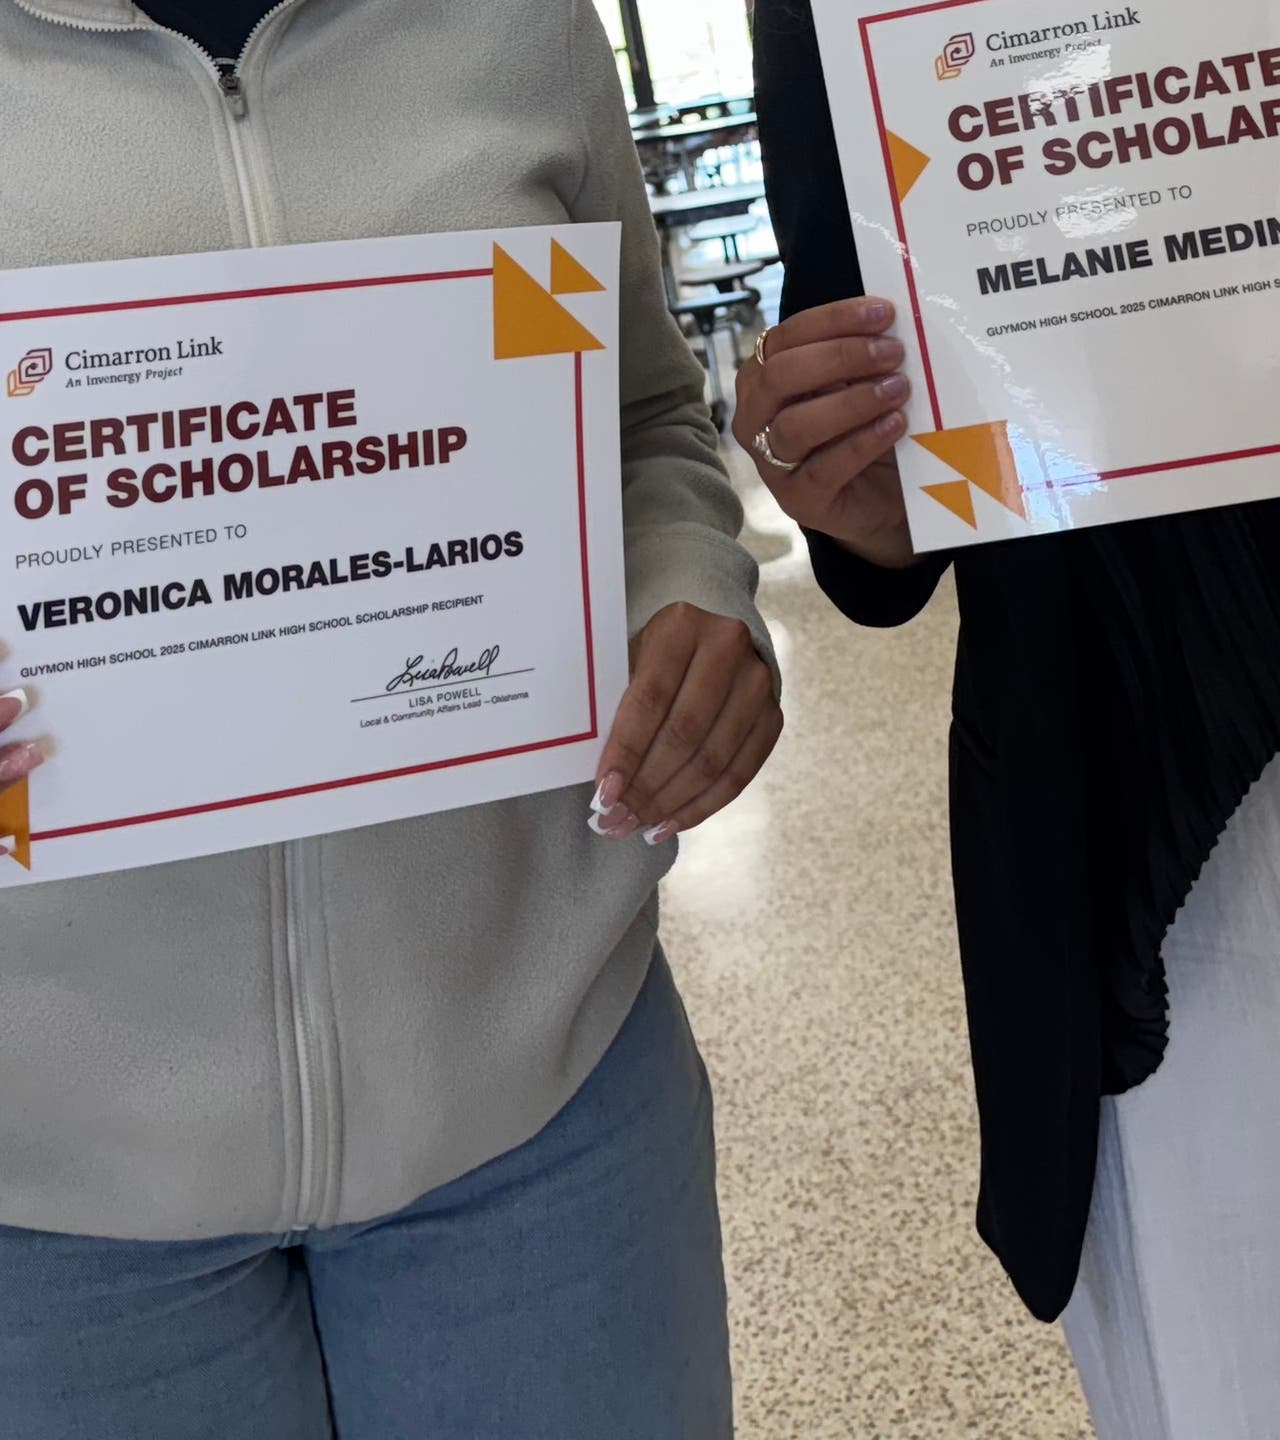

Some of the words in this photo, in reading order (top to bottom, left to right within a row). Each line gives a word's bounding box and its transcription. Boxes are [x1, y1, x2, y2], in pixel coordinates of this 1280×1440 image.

[986, 20, 1088, 51] Cimarron
[1092, 7, 1141, 31] Link
[990, 58, 1005, 68] An
[1008, 46, 1061, 65] Invenergy
[956, 147, 1025, 191] OF
[966, 211, 1049, 237] PROUDLY
[1055, 190, 1161, 220] PRESENTED
[1168, 185, 1193, 201] TO
[976, 239, 1153, 295] MELANIE
[986, 319, 1037, 337] GUYMON
[1039, 314, 1067, 328] HIGH
[1070, 306, 1118, 323] SCHOOL
[1120, 301, 1146, 315] 2025
[1148, 290, 1210, 310] CIMARRON
[1213, 285, 1240, 299] LINK
[1242, 280, 1271, 294] HIGH
[65, 345, 172, 371] Cimarron
[177, 336, 223, 359] Link
[65, 378, 82, 388] An
[87, 372, 141, 385] Invenergy
[146, 366, 183, 381] Project
[11, 388, 357, 467] CERTIFICATE
[14, 474, 88, 520] OF
[106, 426, 468, 508] SCHOLARSHIP
[16, 544, 103, 569] PROUDLY
[112, 528, 217, 556] PRESENTED
[224, 524, 247, 541] TO
[17, 579, 212, 631] VERONICA
[223, 530, 524, 601] MORALES-LARIOS
[20, 661, 74, 678] GUYMON
[77, 655, 106, 669] HIGH
[109, 647, 157, 665] SCHOOL
[160, 643, 185, 656] 2025
[188, 632, 249, 651] CIMARRON
[251, 628, 276, 641] LINK
[279, 624, 306, 637] HIGH
[308, 616, 353, 632] SCHOOL
[355, 603, 429, 625] SCHOLARSHIP
[431, 594, 484, 612] RECIPIENT
[360, 717, 382, 728] Local
[383, 716, 390, 724] &
[391, 707, 435, 723] Community
[437, 702, 461, 714] Affairs
[409, 695, 433, 709] LISA
[436, 687, 481, 703] POWELL
